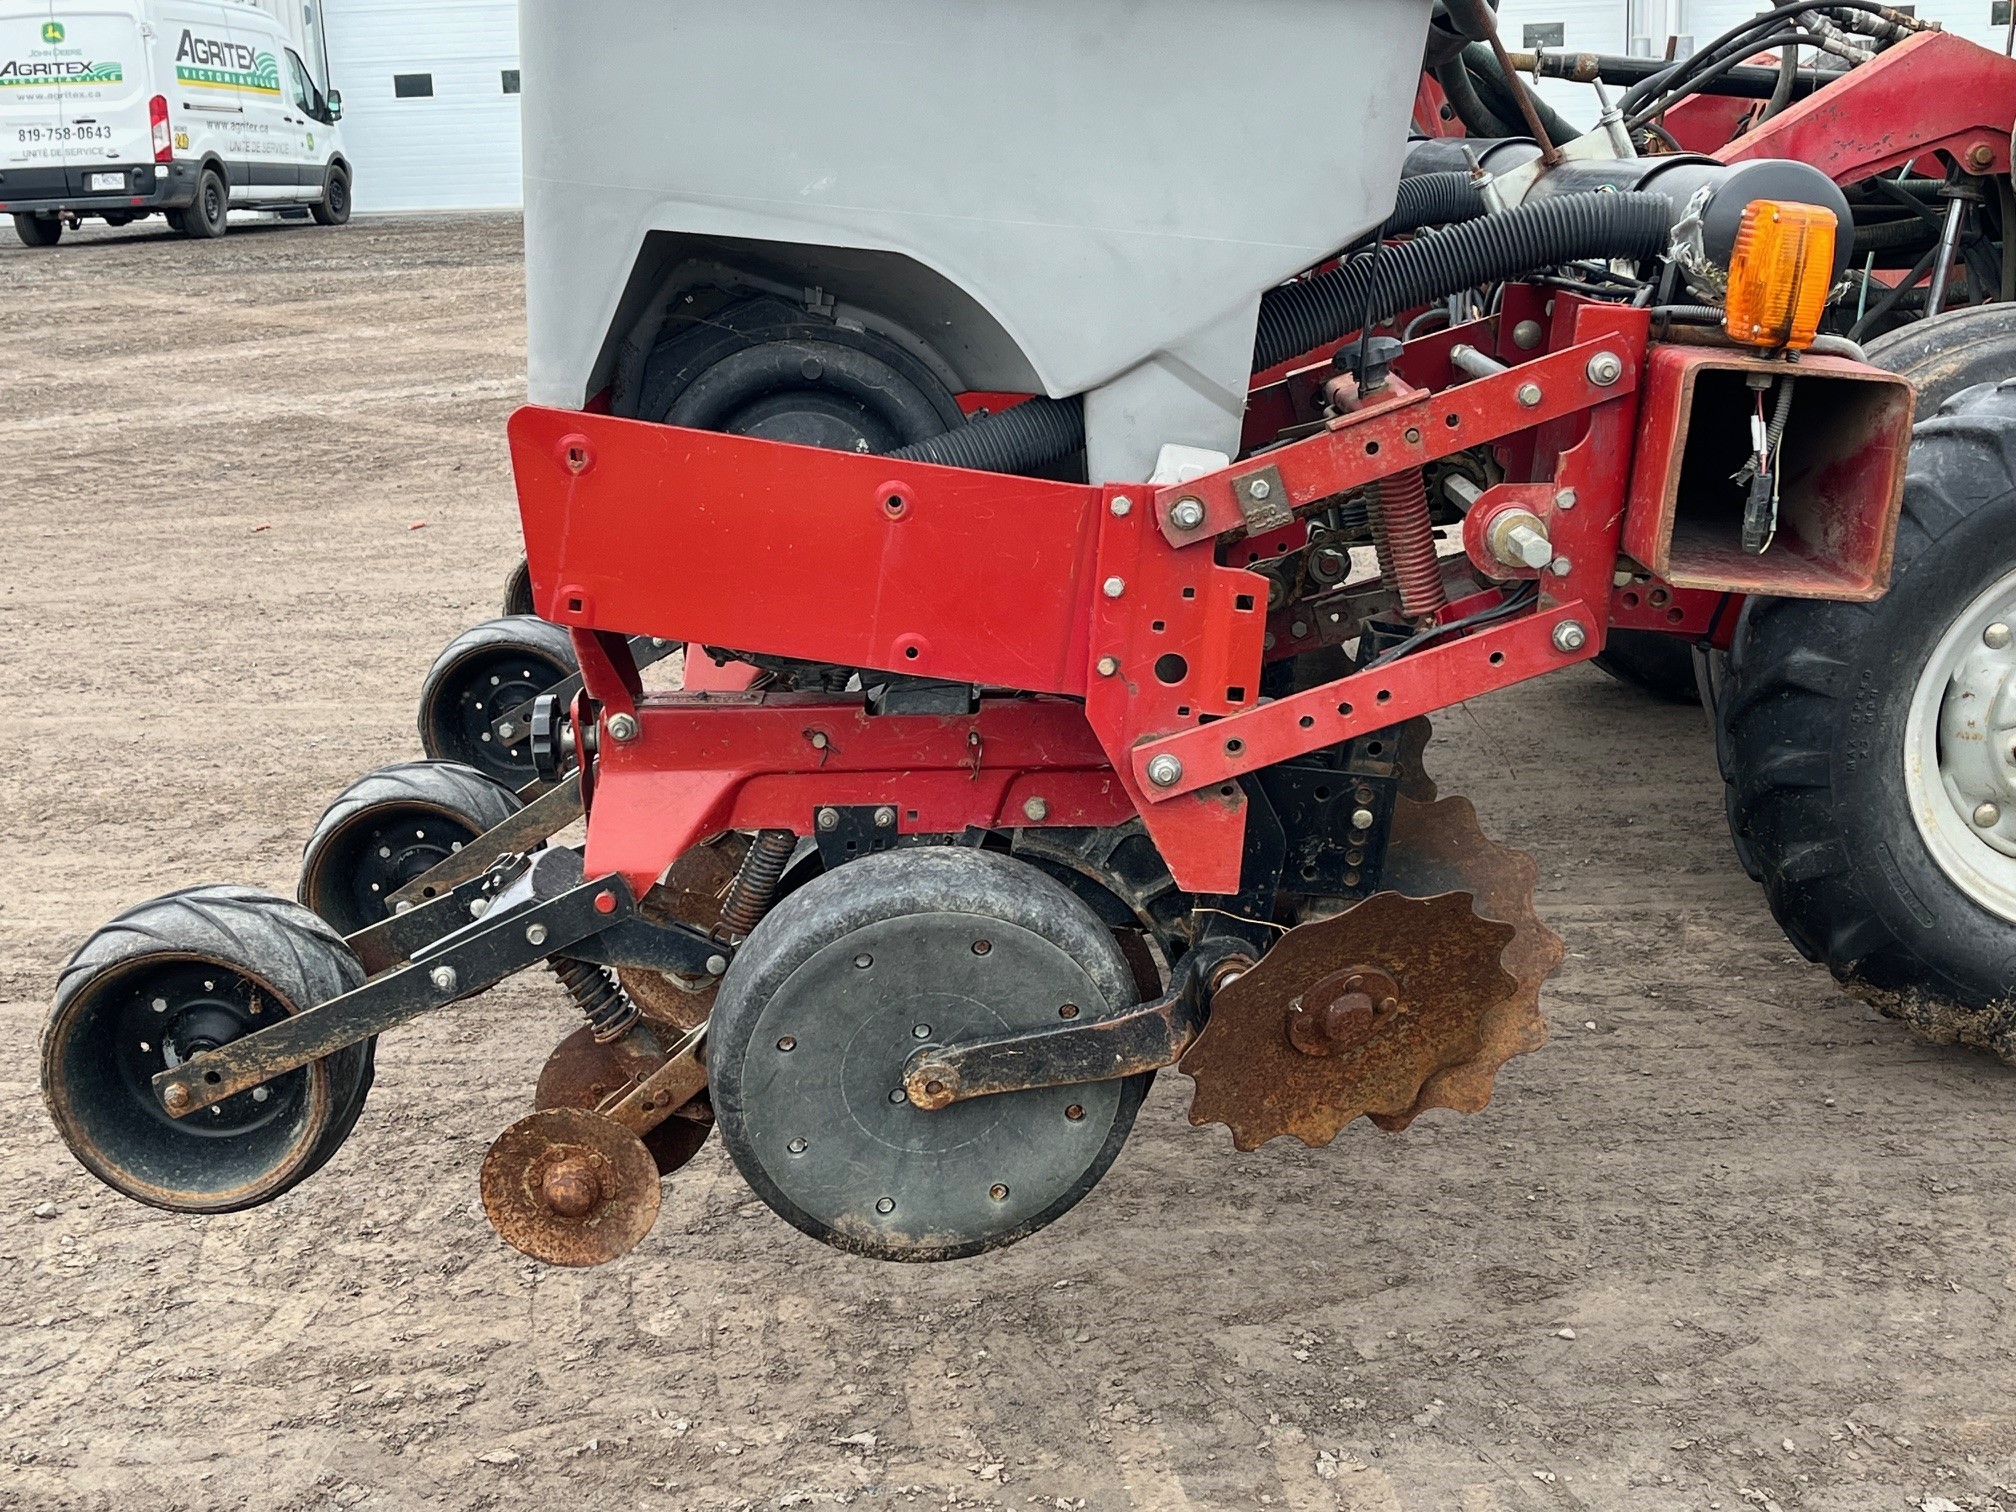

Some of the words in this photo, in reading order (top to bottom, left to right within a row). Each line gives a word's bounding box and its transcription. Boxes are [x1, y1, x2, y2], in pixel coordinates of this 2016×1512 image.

[28, 49, 52, 58] JOHN
[53, 48, 82, 56] DEERE
[175, 28, 260, 71] AGRITEX
[0, 60, 94, 77] AGRITEX
[3, 74, 117, 85] VICTORIAVILLE
[182, 68, 277, 88] VICTORIAVILLE
[16, 91, 102, 101] www.agritex.ca
[18, 125, 112, 142] 819-758-0643
[206, 120, 269, 134] www.agritex.ca
[22, 148, 49, 158] UNITÉ
[50, 149, 63, 157] DE
[65, 147, 104, 156] SERVICE
